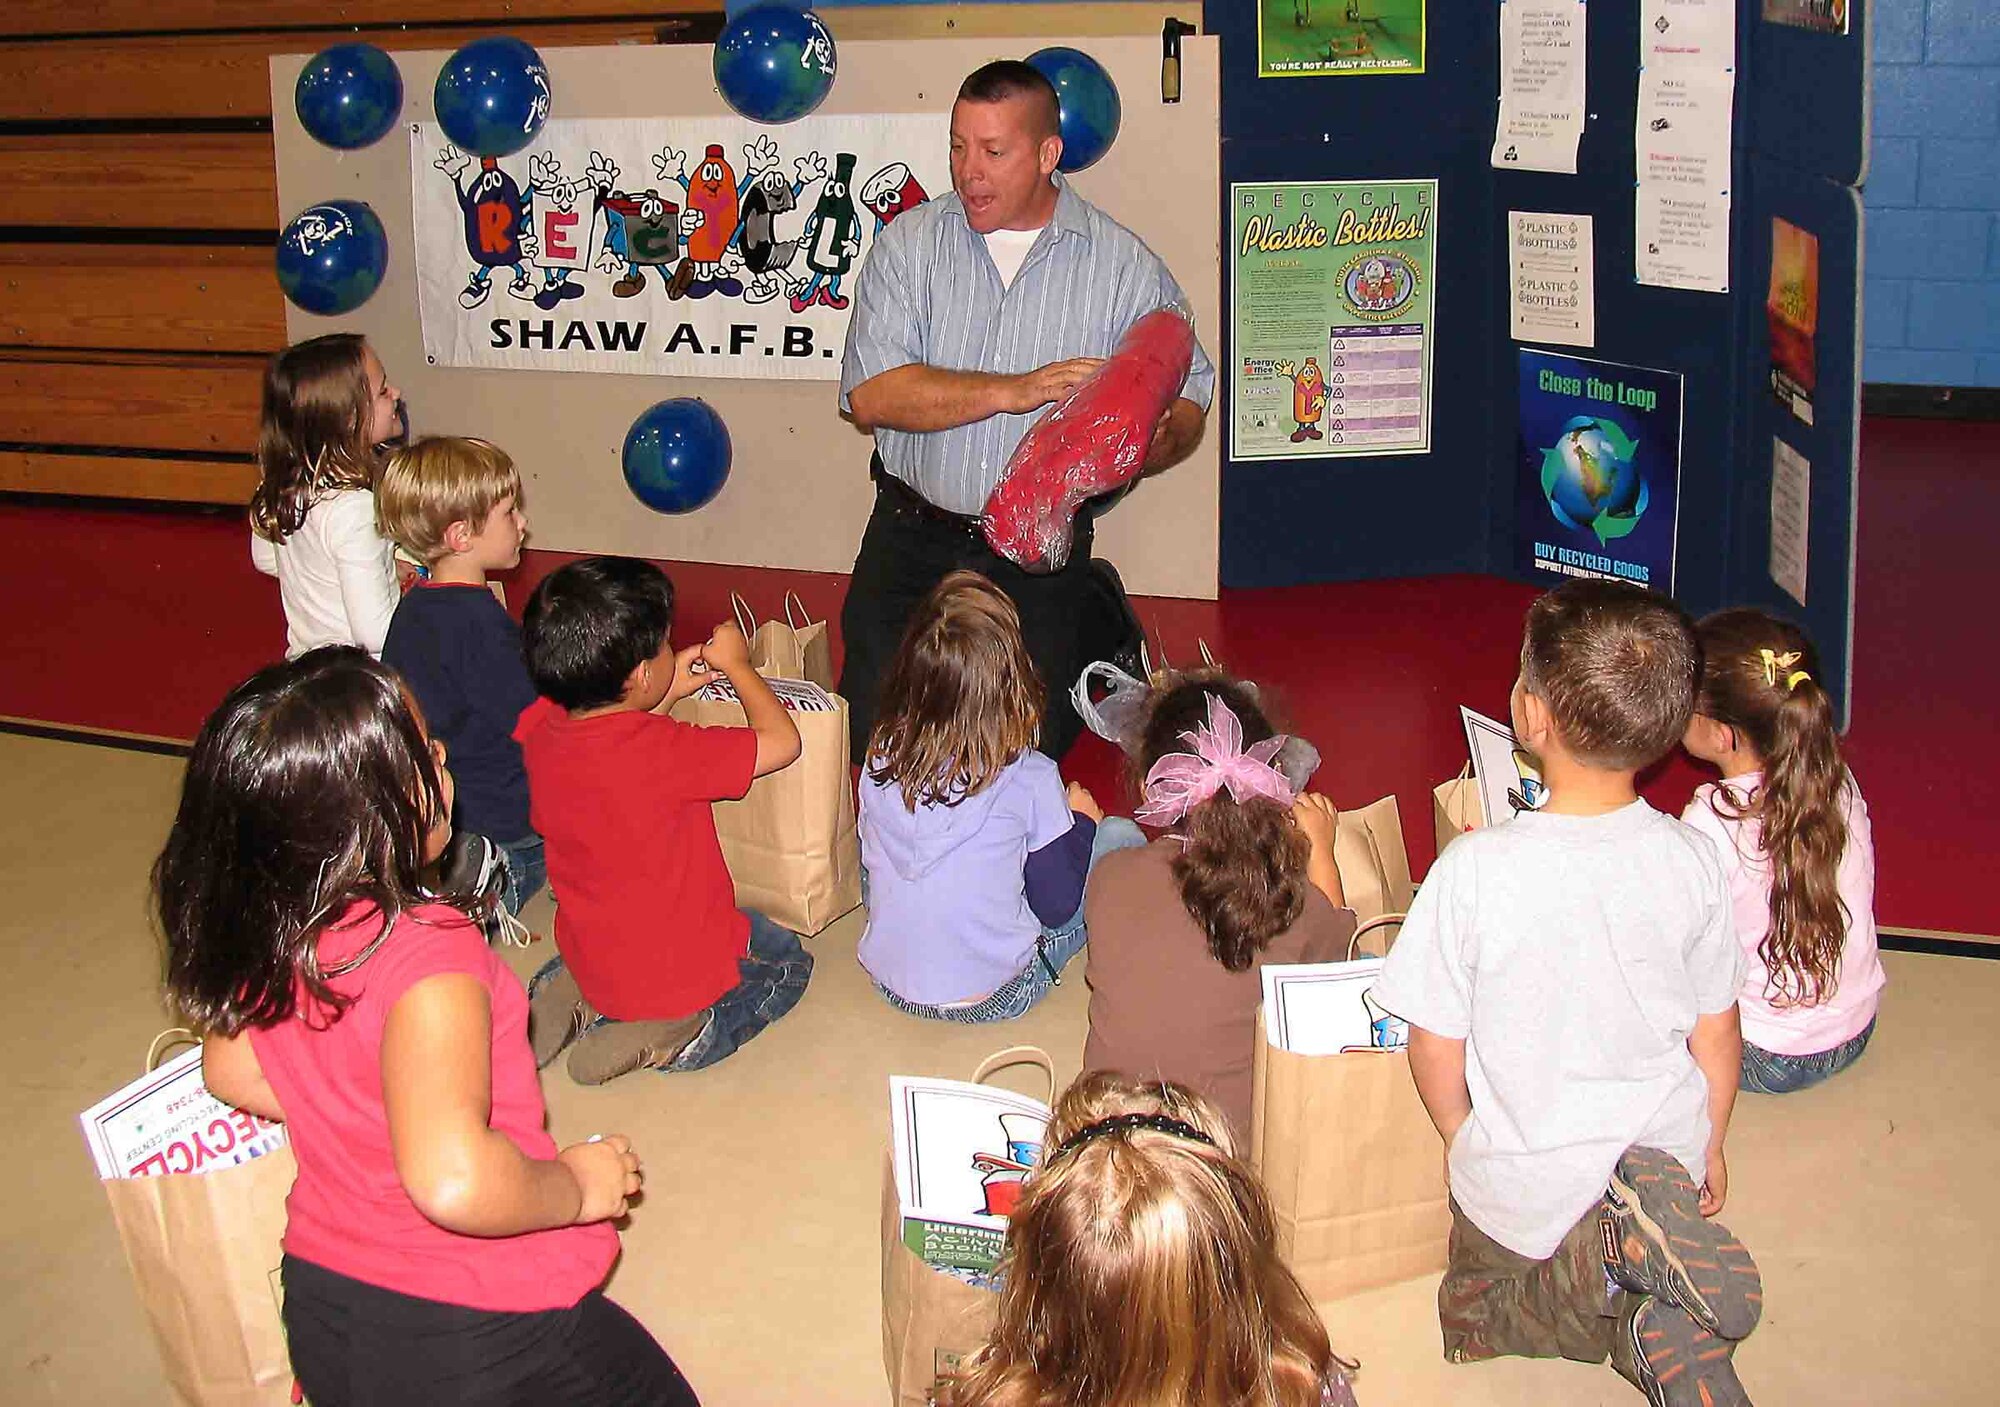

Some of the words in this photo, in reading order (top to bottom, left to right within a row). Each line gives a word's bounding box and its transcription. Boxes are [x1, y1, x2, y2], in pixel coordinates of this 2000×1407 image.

[1269, 57, 1300, 71] YOU'RE
[1303, 61, 1322, 70] NOT
[1324, 60, 1358, 70] REALLY
[1243, 190, 1429, 209] RECYCLE
[476, 192, 838, 270] RECYCL
[1241, 211, 1328, 257] Plastic
[1332, 203, 1430, 247] Bottles!
[1526, 222, 1567, 234] PLASTIC
[1525, 239, 1570, 250] BOTTLES
[1527, 279, 1567, 292] PLASTIC
[1526, 295, 1570, 307] BOTTLES
[489, 319, 648, 353] SHAW
[663, 322, 834, 359] A.F.B.
[1244, 357, 1276, 367] Energy
[1540, 369, 1581, 396] Close
[1586, 378, 1614, 402] the
[1618, 381, 1656, 411] Loop
[1534, 541, 1557, 561] BUY
[1558, 546, 1611, 573] RECYCLED
[1613, 560, 1649, 581] GOODS
[129, 1106, 277, 1176] ECYCLE
